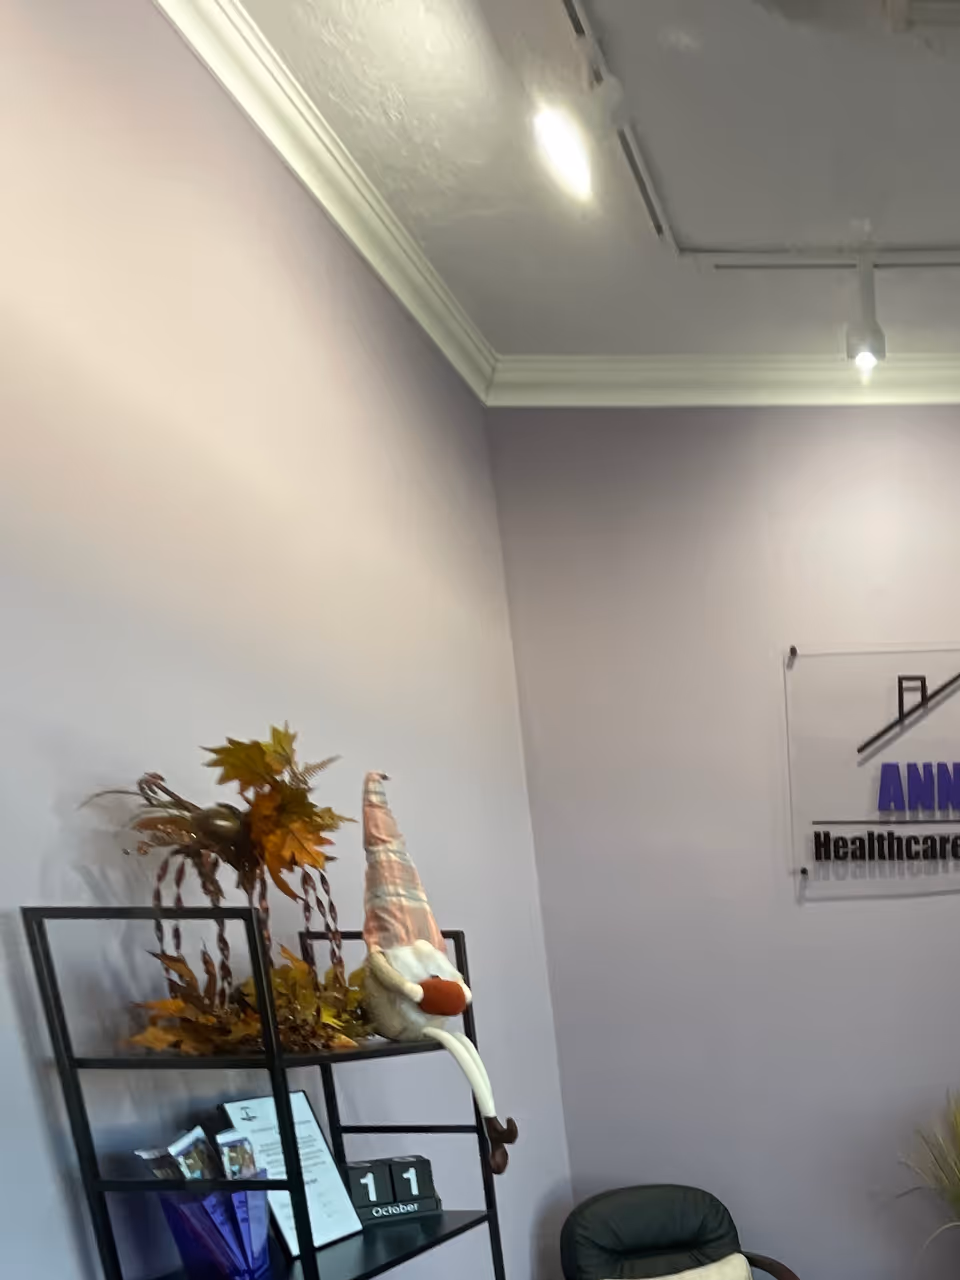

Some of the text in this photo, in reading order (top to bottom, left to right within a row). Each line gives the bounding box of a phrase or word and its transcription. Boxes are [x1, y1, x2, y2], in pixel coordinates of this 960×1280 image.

[360, 1167, 419, 1202] 1 1
[371, 1203, 420, 1218] October
